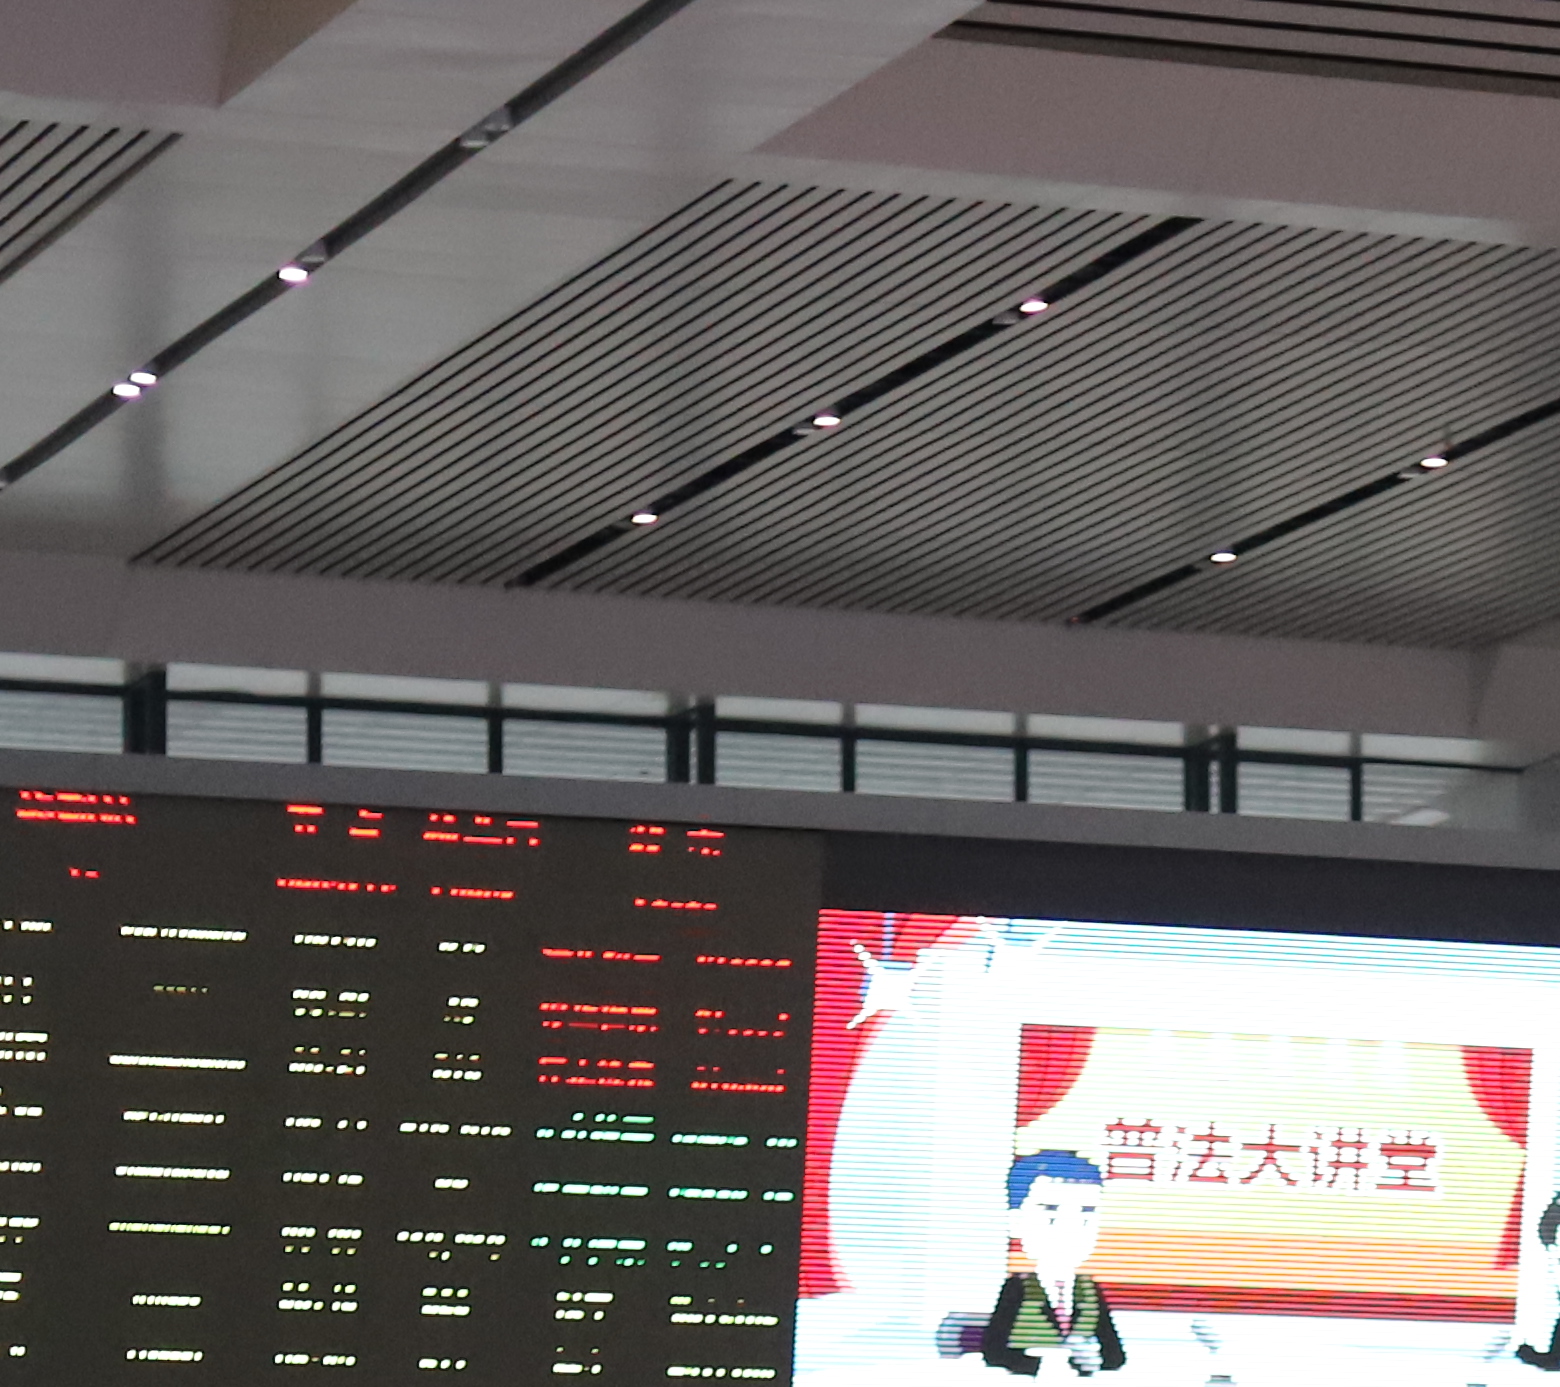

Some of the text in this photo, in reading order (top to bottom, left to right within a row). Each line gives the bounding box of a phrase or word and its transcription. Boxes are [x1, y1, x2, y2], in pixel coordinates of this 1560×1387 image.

[1102, 1116, 1439, 1194] 普法大讲堂
